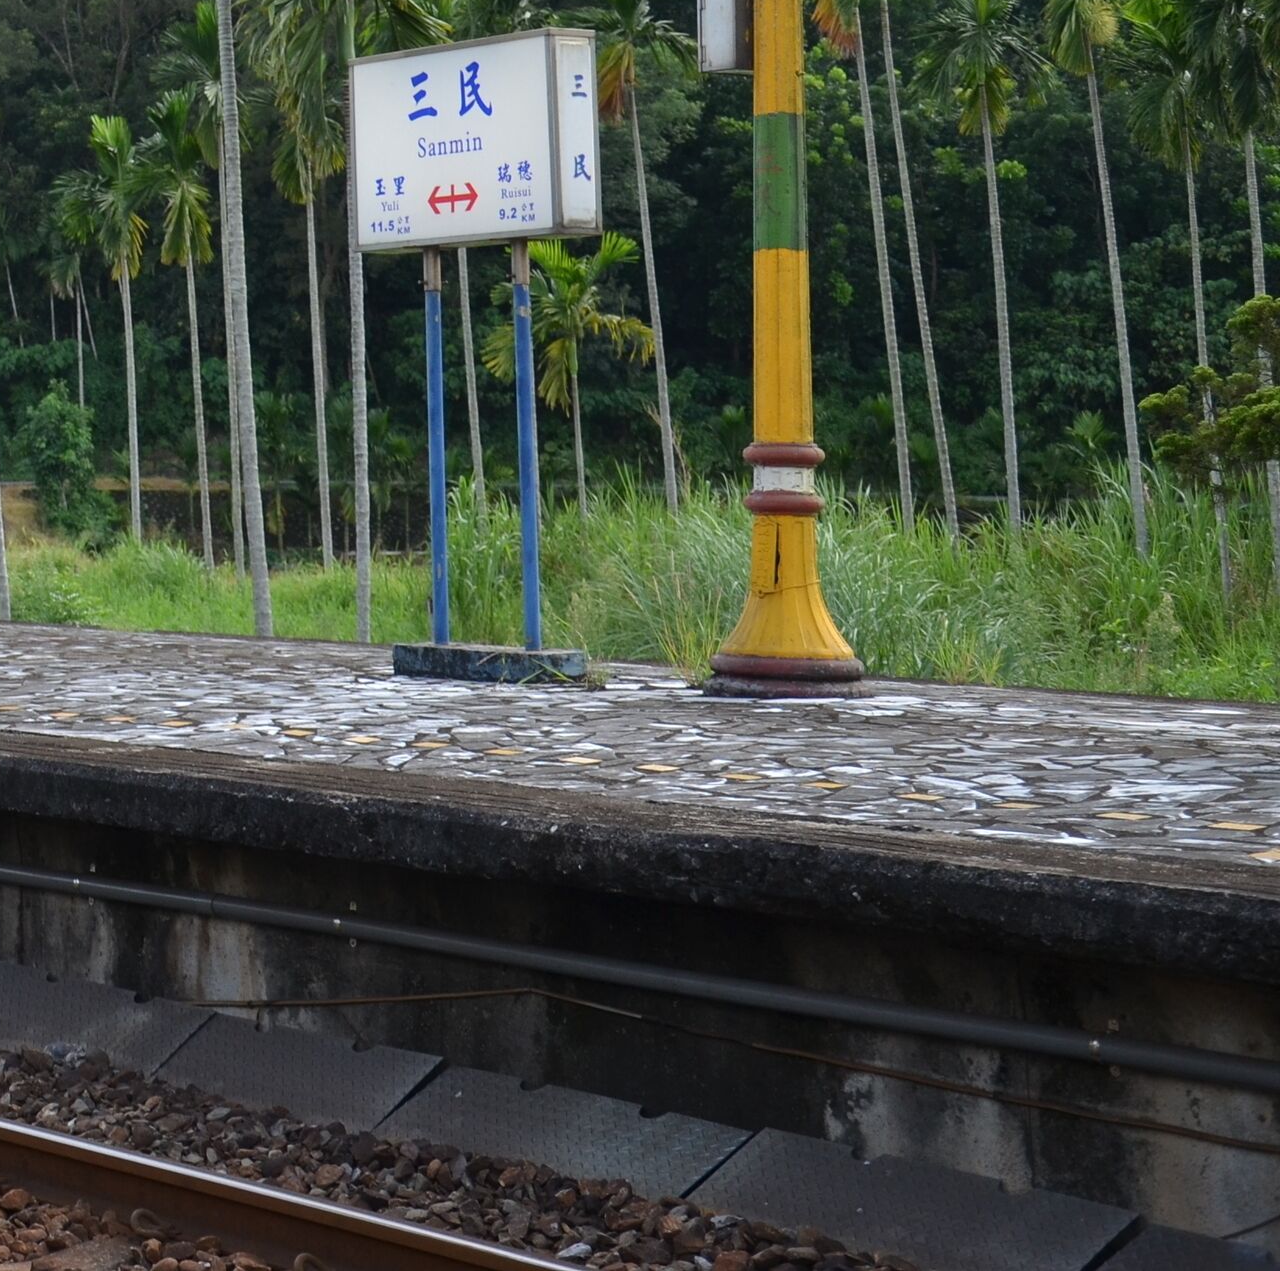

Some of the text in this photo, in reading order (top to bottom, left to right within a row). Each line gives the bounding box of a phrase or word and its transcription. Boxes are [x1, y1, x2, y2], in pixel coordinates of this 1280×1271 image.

[407, 60, 493, 122] 三民
[570, 73, 592, 182] 三民
[416, 131, 484, 159] Sanmin
[497, 160, 533, 184] 瑞穗
[375, 175, 406, 197] 玉里
[500, 185, 532, 200] Ruisui
[381, 199, 400, 213] Yuli
[498, 207, 518, 221] 9.2
[521, 213, 536, 223] KM
[370, 219, 396, 233] 11.5
[397, 225, 411, 235] KM
